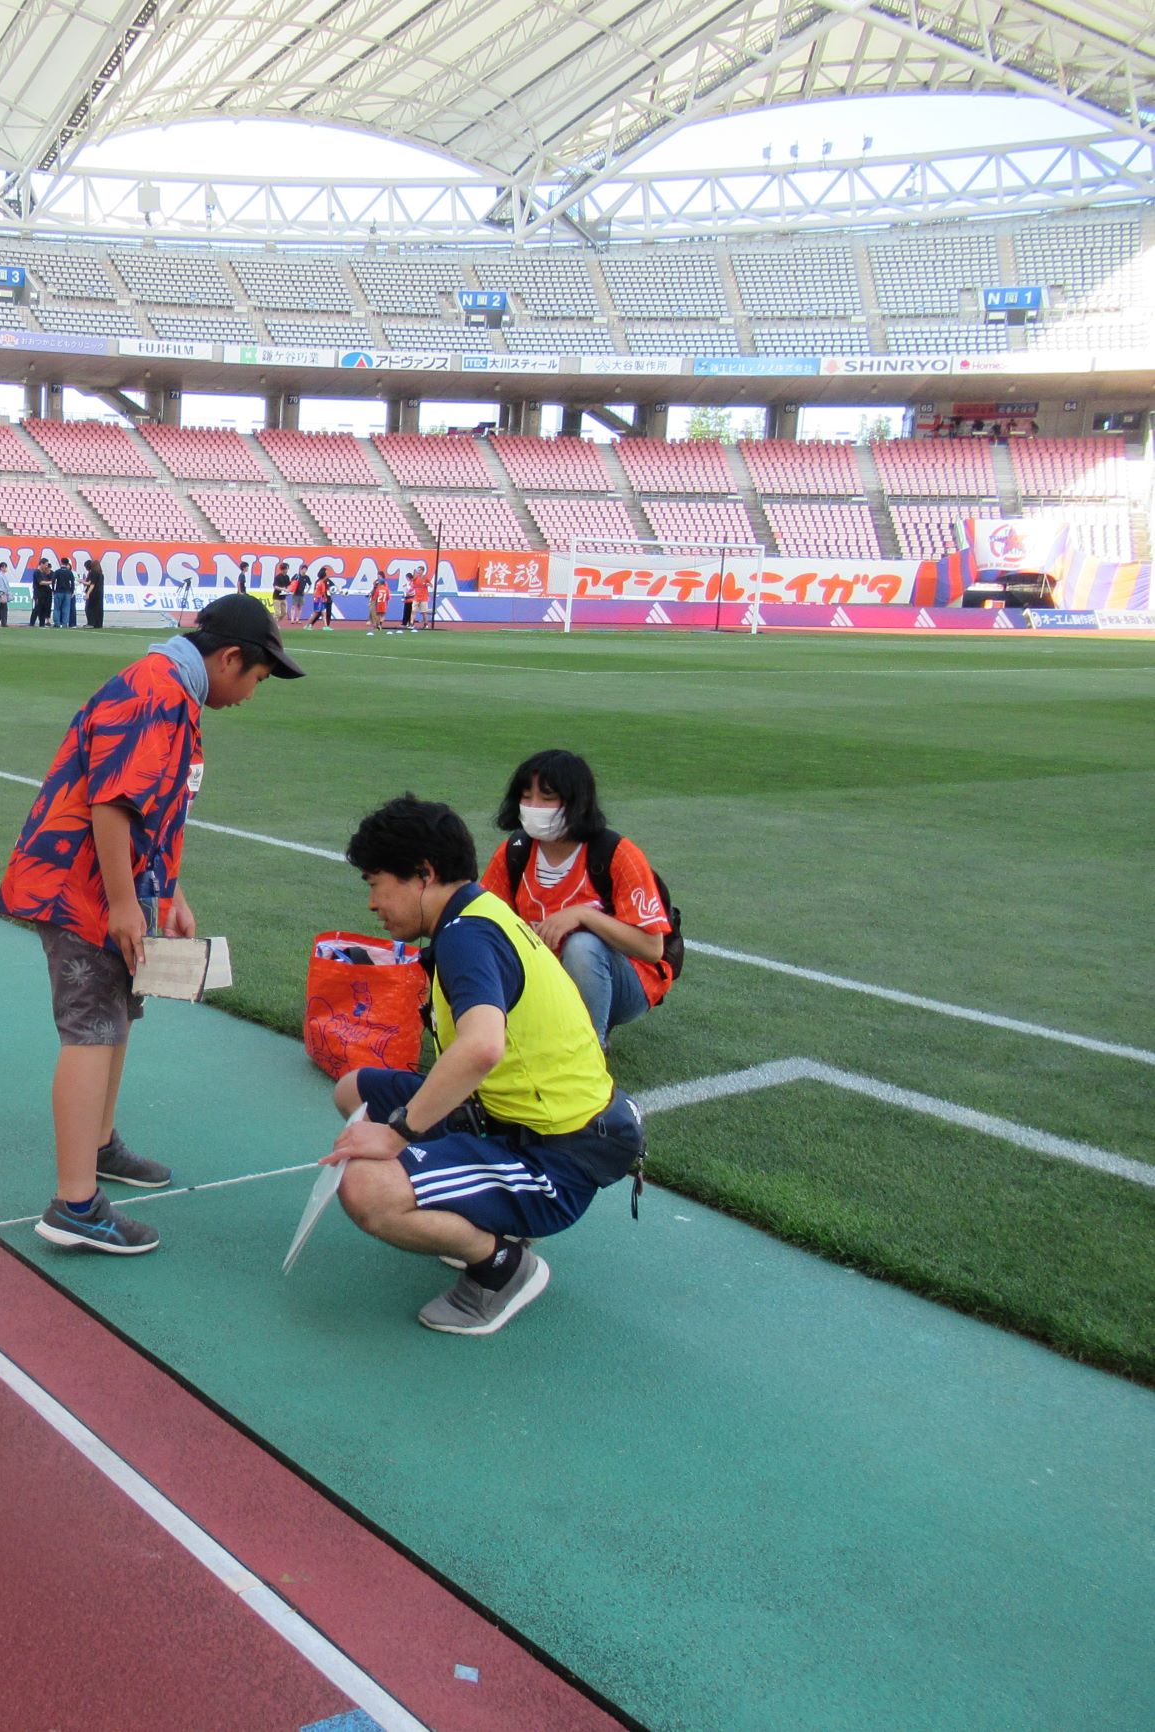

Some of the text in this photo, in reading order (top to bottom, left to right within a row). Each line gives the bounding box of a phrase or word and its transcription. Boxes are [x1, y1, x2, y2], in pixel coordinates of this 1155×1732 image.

[12, 270, 19, 283] 3
[462, 295, 500, 306] N 2
[988, 291, 1032, 305] N 1
[21, 337, 104, 350] おおつかこどもクリニック
[138, 342, 194, 356] FUJIFILM
[376, 355, 449, 369] アドヴァンス
[490, 358, 557, 369] 大川スティール
[612, 360, 668, 370] 大谷製作所
[844, 359, 948, 373] SHINRYO
[655, 404, 665, 412] 67
[921, 404, 932, 413] 65
[1064, 402, 1076, 411] 64
[213, 553, 459, 595] NIIGATA
[484, 560, 542, 588] 橙魂
[573, 567, 903, 604] アイシテルニイガタ
[105, 593, 135, 604] 備保障
[377, 591, 387, 602] 21
[160, 597, 206, 609] 山崎食
